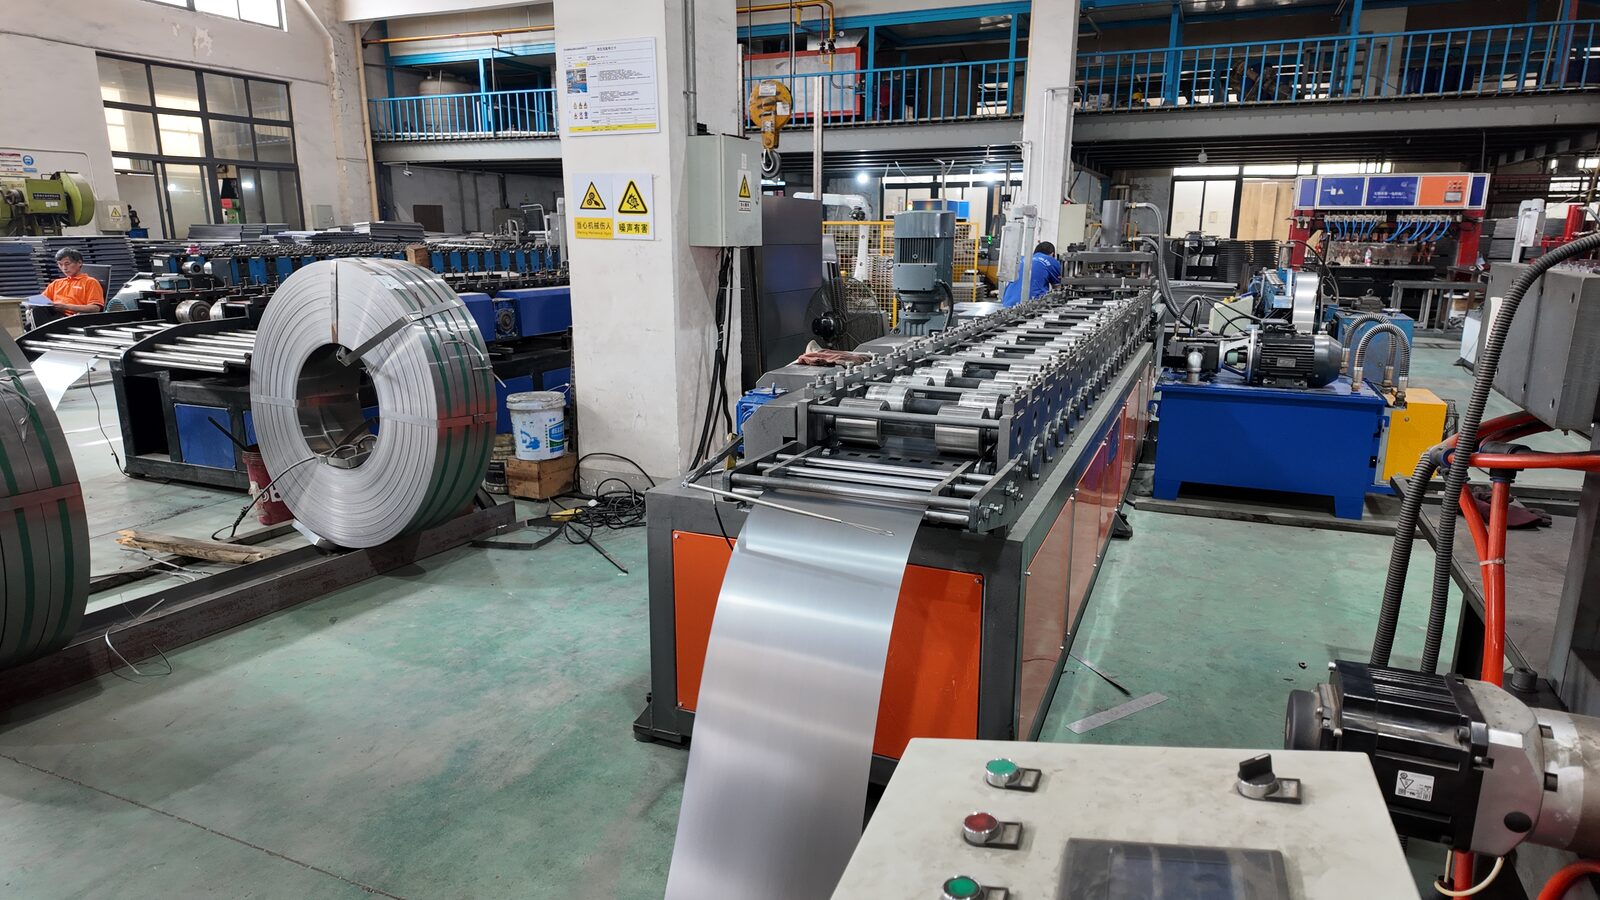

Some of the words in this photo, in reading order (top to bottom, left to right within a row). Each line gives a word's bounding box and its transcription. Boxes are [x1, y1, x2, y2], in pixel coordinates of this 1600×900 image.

[577, 221, 611, 230] 当心机械伤人
[619, 223, 648, 233] 噪声有害
